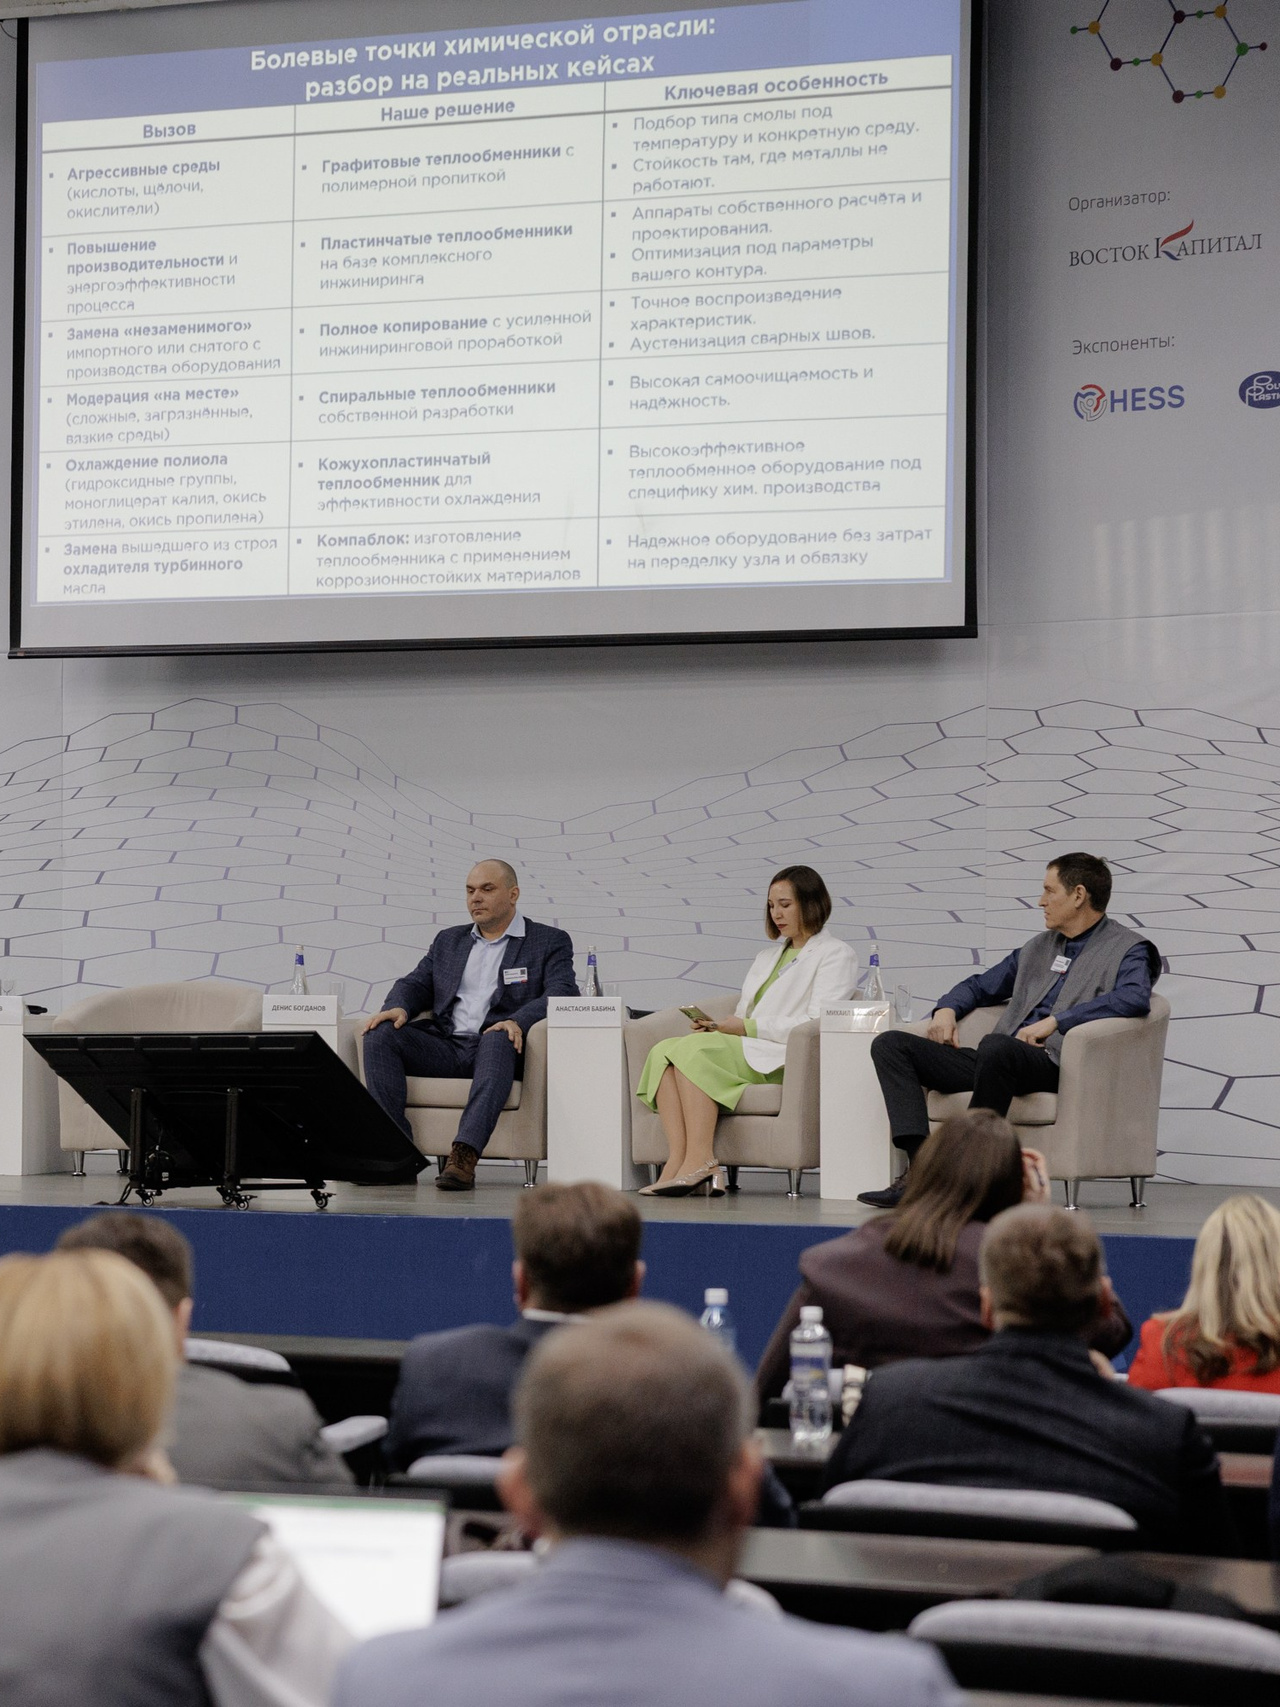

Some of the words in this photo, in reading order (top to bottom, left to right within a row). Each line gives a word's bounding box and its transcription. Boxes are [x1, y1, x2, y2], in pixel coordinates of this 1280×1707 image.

[251, 47, 357, 70] Болевые
[364, 40, 435, 61] точки
[443, 23, 594, 55] химической
[602, 18, 714, 44] отрасли:
[305, 73, 393, 101] разбор
[401, 73, 428, 89] на
[437, 63, 558, 91] реальных
[567, 54, 654, 77] кейсах
[664, 82, 758, 100] Ключевая
[764, 72, 888, 93] особенность
[381, 106, 429, 121] Наше
[434, 100, 515, 120] решение
[633, 114, 696, 131] Подбор
[700, 113, 738, 125] типа
[743, 109, 796, 123] смолы
[801, 106, 832, 119] под
[143, 123, 196, 138] Вызов
[633, 134, 738, 151] температуру
[743, 132, 752, 143] и
[758, 125, 860, 142] конкретную
[864, 121, 919, 137] среду.
[322, 156, 420, 174] Графитовые
[425, 146, 560, 165] теплообменники
[565, 146, 573, 156] с
[633, 156, 718, 171] Стойкость
[722, 153, 754, 165] там,
[760, 151, 786, 164] где
[792, 146, 862, 161] металлы
[867, 143, 888, 155] не
[67, 164, 167, 181] Агрессивные
[172, 160, 219, 175] среды
[321, 175, 416, 192] полимерной
[421, 168, 505, 188] пропиткой
[66, 186, 138, 201] (кислоты,
[1068, 190, 1170, 212] Организатор:
[66, 201, 159, 218] окислители)
[632, 205, 712, 220] Аппараты
[717, 197, 833, 214] собственного
[911, 191, 921, 202] и
[67, 240, 156, 255] Повышение
[321, 233, 432, 250] Пластинчатые
[436, 224, 572, 243] теплообменники
[631, 244, 740, 261] Оптимизация
[746, 242, 776, 255] под
[781, 236, 873, 254] параметры
[1068, 243, 1149, 266] ВОСТОК
[67, 255, 223, 276] производительности
[229, 255, 237, 264] и
[631, 295, 689, 309] Точное
[695, 287, 842, 307] воспроизведение
[66, 327, 118, 340] Замена
[319, 323, 378, 336] Полное
[383, 317, 487, 334] копирование
[492, 317, 500, 326] с
[506, 312, 591, 329] усиленной
[319, 338, 452, 356] инжиниринговой
[457, 332, 562, 351] проработкой
[630, 335, 745, 352] Аустенизация
[750, 331, 820, 345] сварных
[826, 328, 875, 340] швов.
[1071, 335, 1174, 355] Экспоненты:
[66, 364, 166, 380] производства
[171, 358, 280, 374] оборудования
[629, 375, 699, 388] Высокая
[704, 368, 858, 385] самоочищаемость
[863, 367, 873, 378] и
[1253, 375, 1280, 390] POL
[66, 391, 148, 406] Модерация
[318, 389, 416, 405] Спиральные
[420, 382, 555, 398] теплообменники
[1110, 384, 1184, 412] HESS
[318, 406, 417, 423] собственной
[422, 403, 513, 421] разработки
[629, 441, 805, 457] Высокоэффективное
[65, 457, 158, 471] Охлаждение
[163, 454, 227, 466] полиола
[318, 451, 490, 472] Кожухопластинчатый
[628, 463, 755, 478] теплообменное
[761, 459, 884, 475] оборудование
[890, 457, 921, 471] под
[317, 475, 439, 490] теплообменник
[443, 475, 471, 487] для
[63, 542, 117, 555] Замена
[121, 541, 208, 553] вышедшего
[213, 540, 229, 550] из
[234, 538, 277, 552] строя
[317, 532, 409, 546] Компаблок:
[414, 530, 521, 544] изготовление
[628, 534, 710, 549] Надежное
[715, 531, 837, 547] оборудование
[842, 528, 870, 541] без
[876, 528, 932, 543] затрат
[63, 562, 149, 576] охладителя
[153, 558, 243, 574] турбинного
[316, 570, 481, 589] коррозионностойких
[486, 569, 580, 583] материалов
[271, 1004, 292, 1012] ДЕНИС
